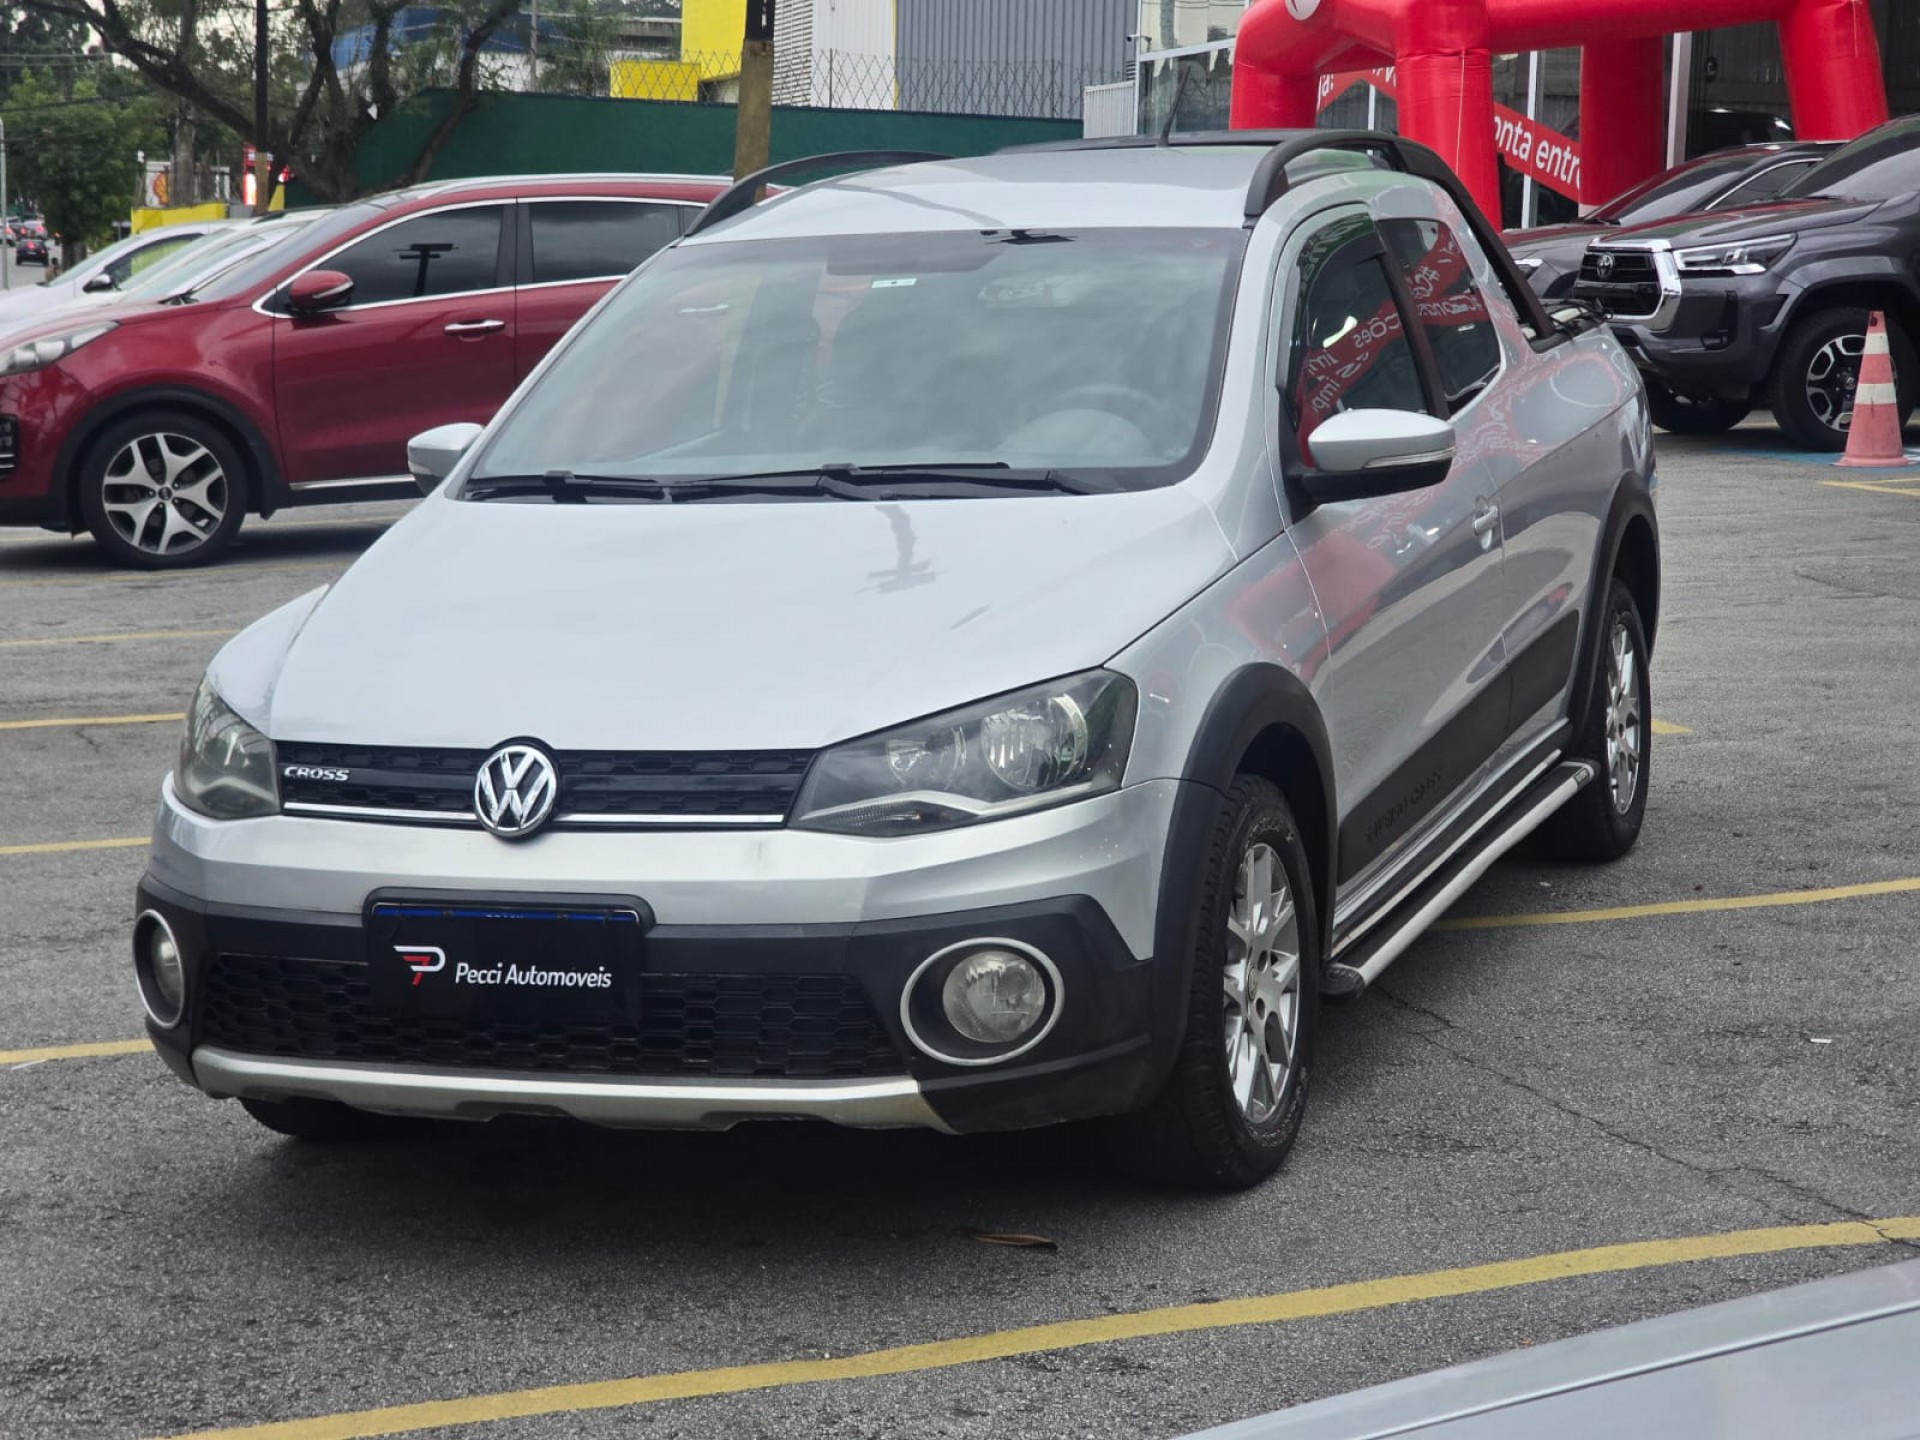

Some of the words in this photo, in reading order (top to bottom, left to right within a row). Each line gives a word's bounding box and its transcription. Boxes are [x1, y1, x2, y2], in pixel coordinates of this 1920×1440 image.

[1535, 140, 1580, 191] entr
[283, 765, 350, 782] CROSS
[454, 962, 502, 985] Pecci
[504, 963, 612, 988] Automoveis
